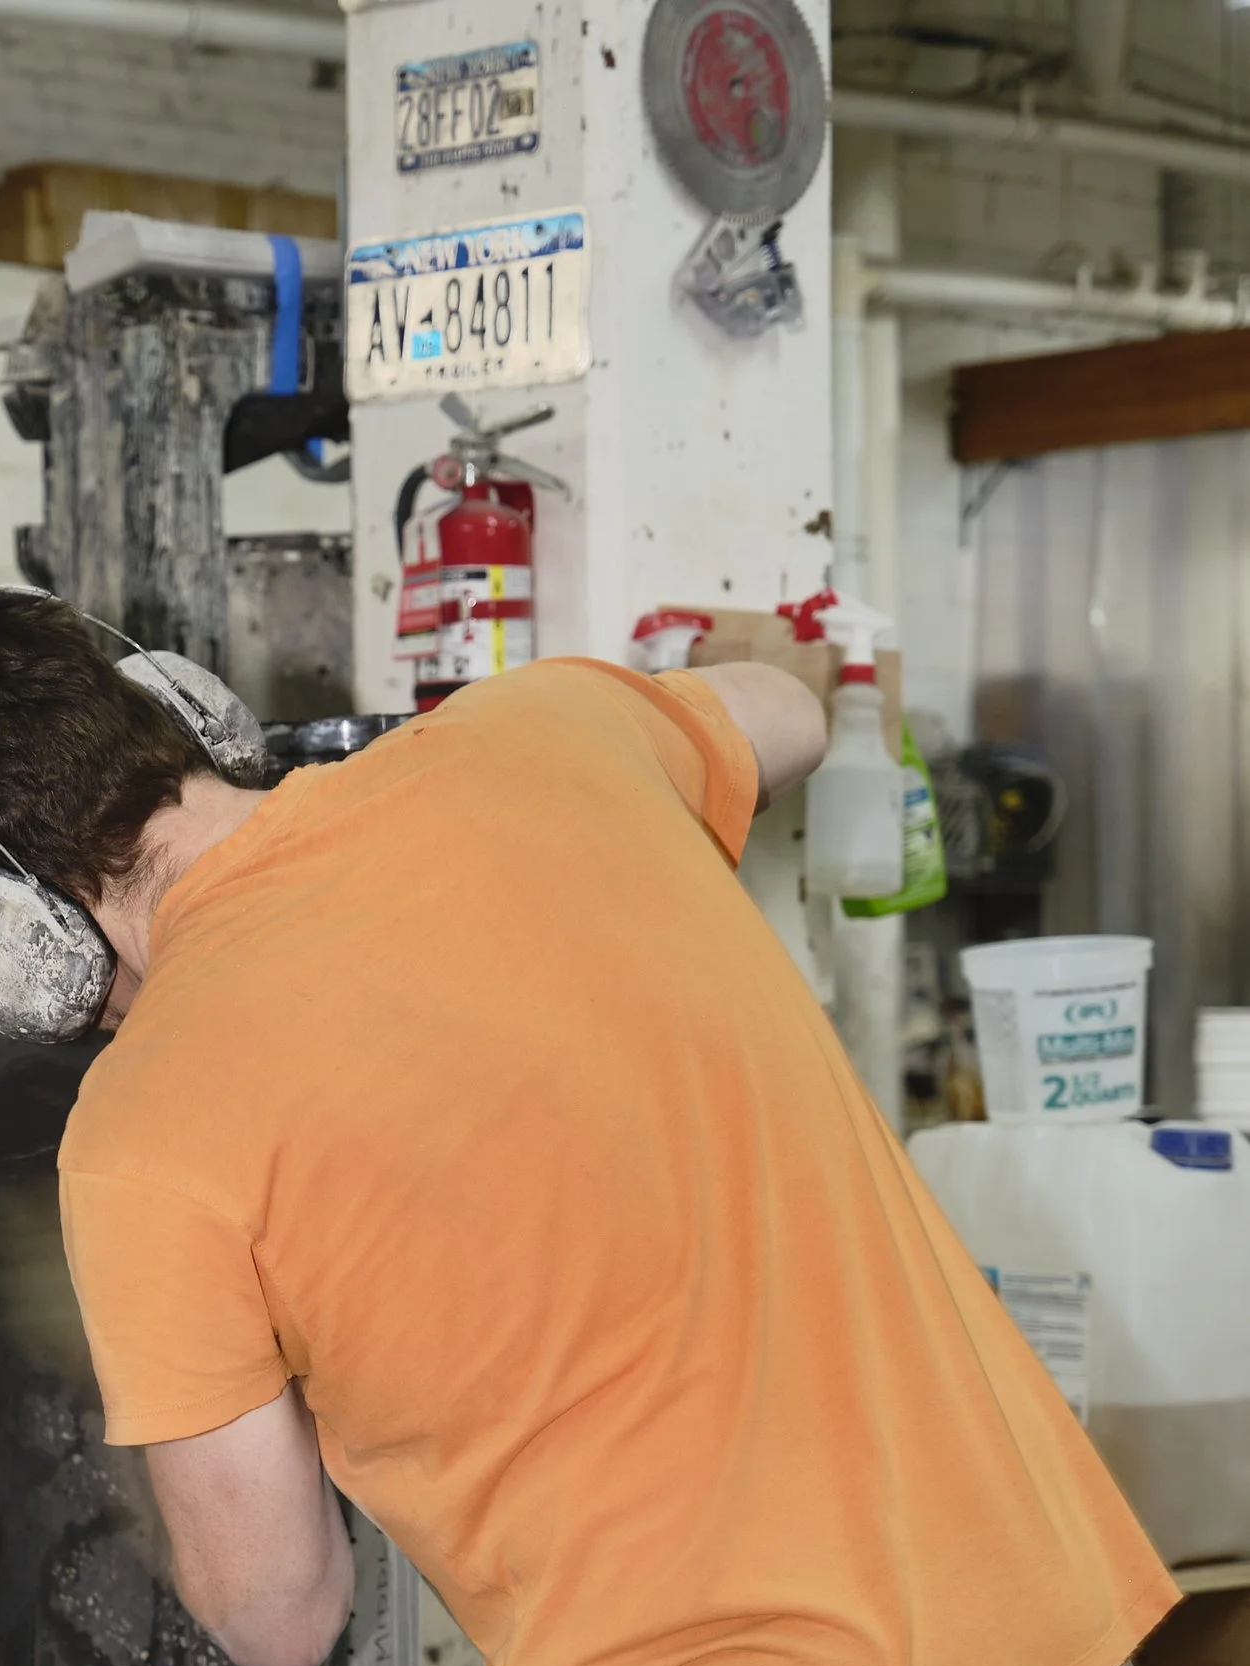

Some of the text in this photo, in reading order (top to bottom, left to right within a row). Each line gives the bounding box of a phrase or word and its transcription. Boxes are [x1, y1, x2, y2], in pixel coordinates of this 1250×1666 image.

[395, 223, 533, 278] NEW YORK
[366, 262, 554, 363] AV 84811
[1043, 1074, 1068, 1110] 2
